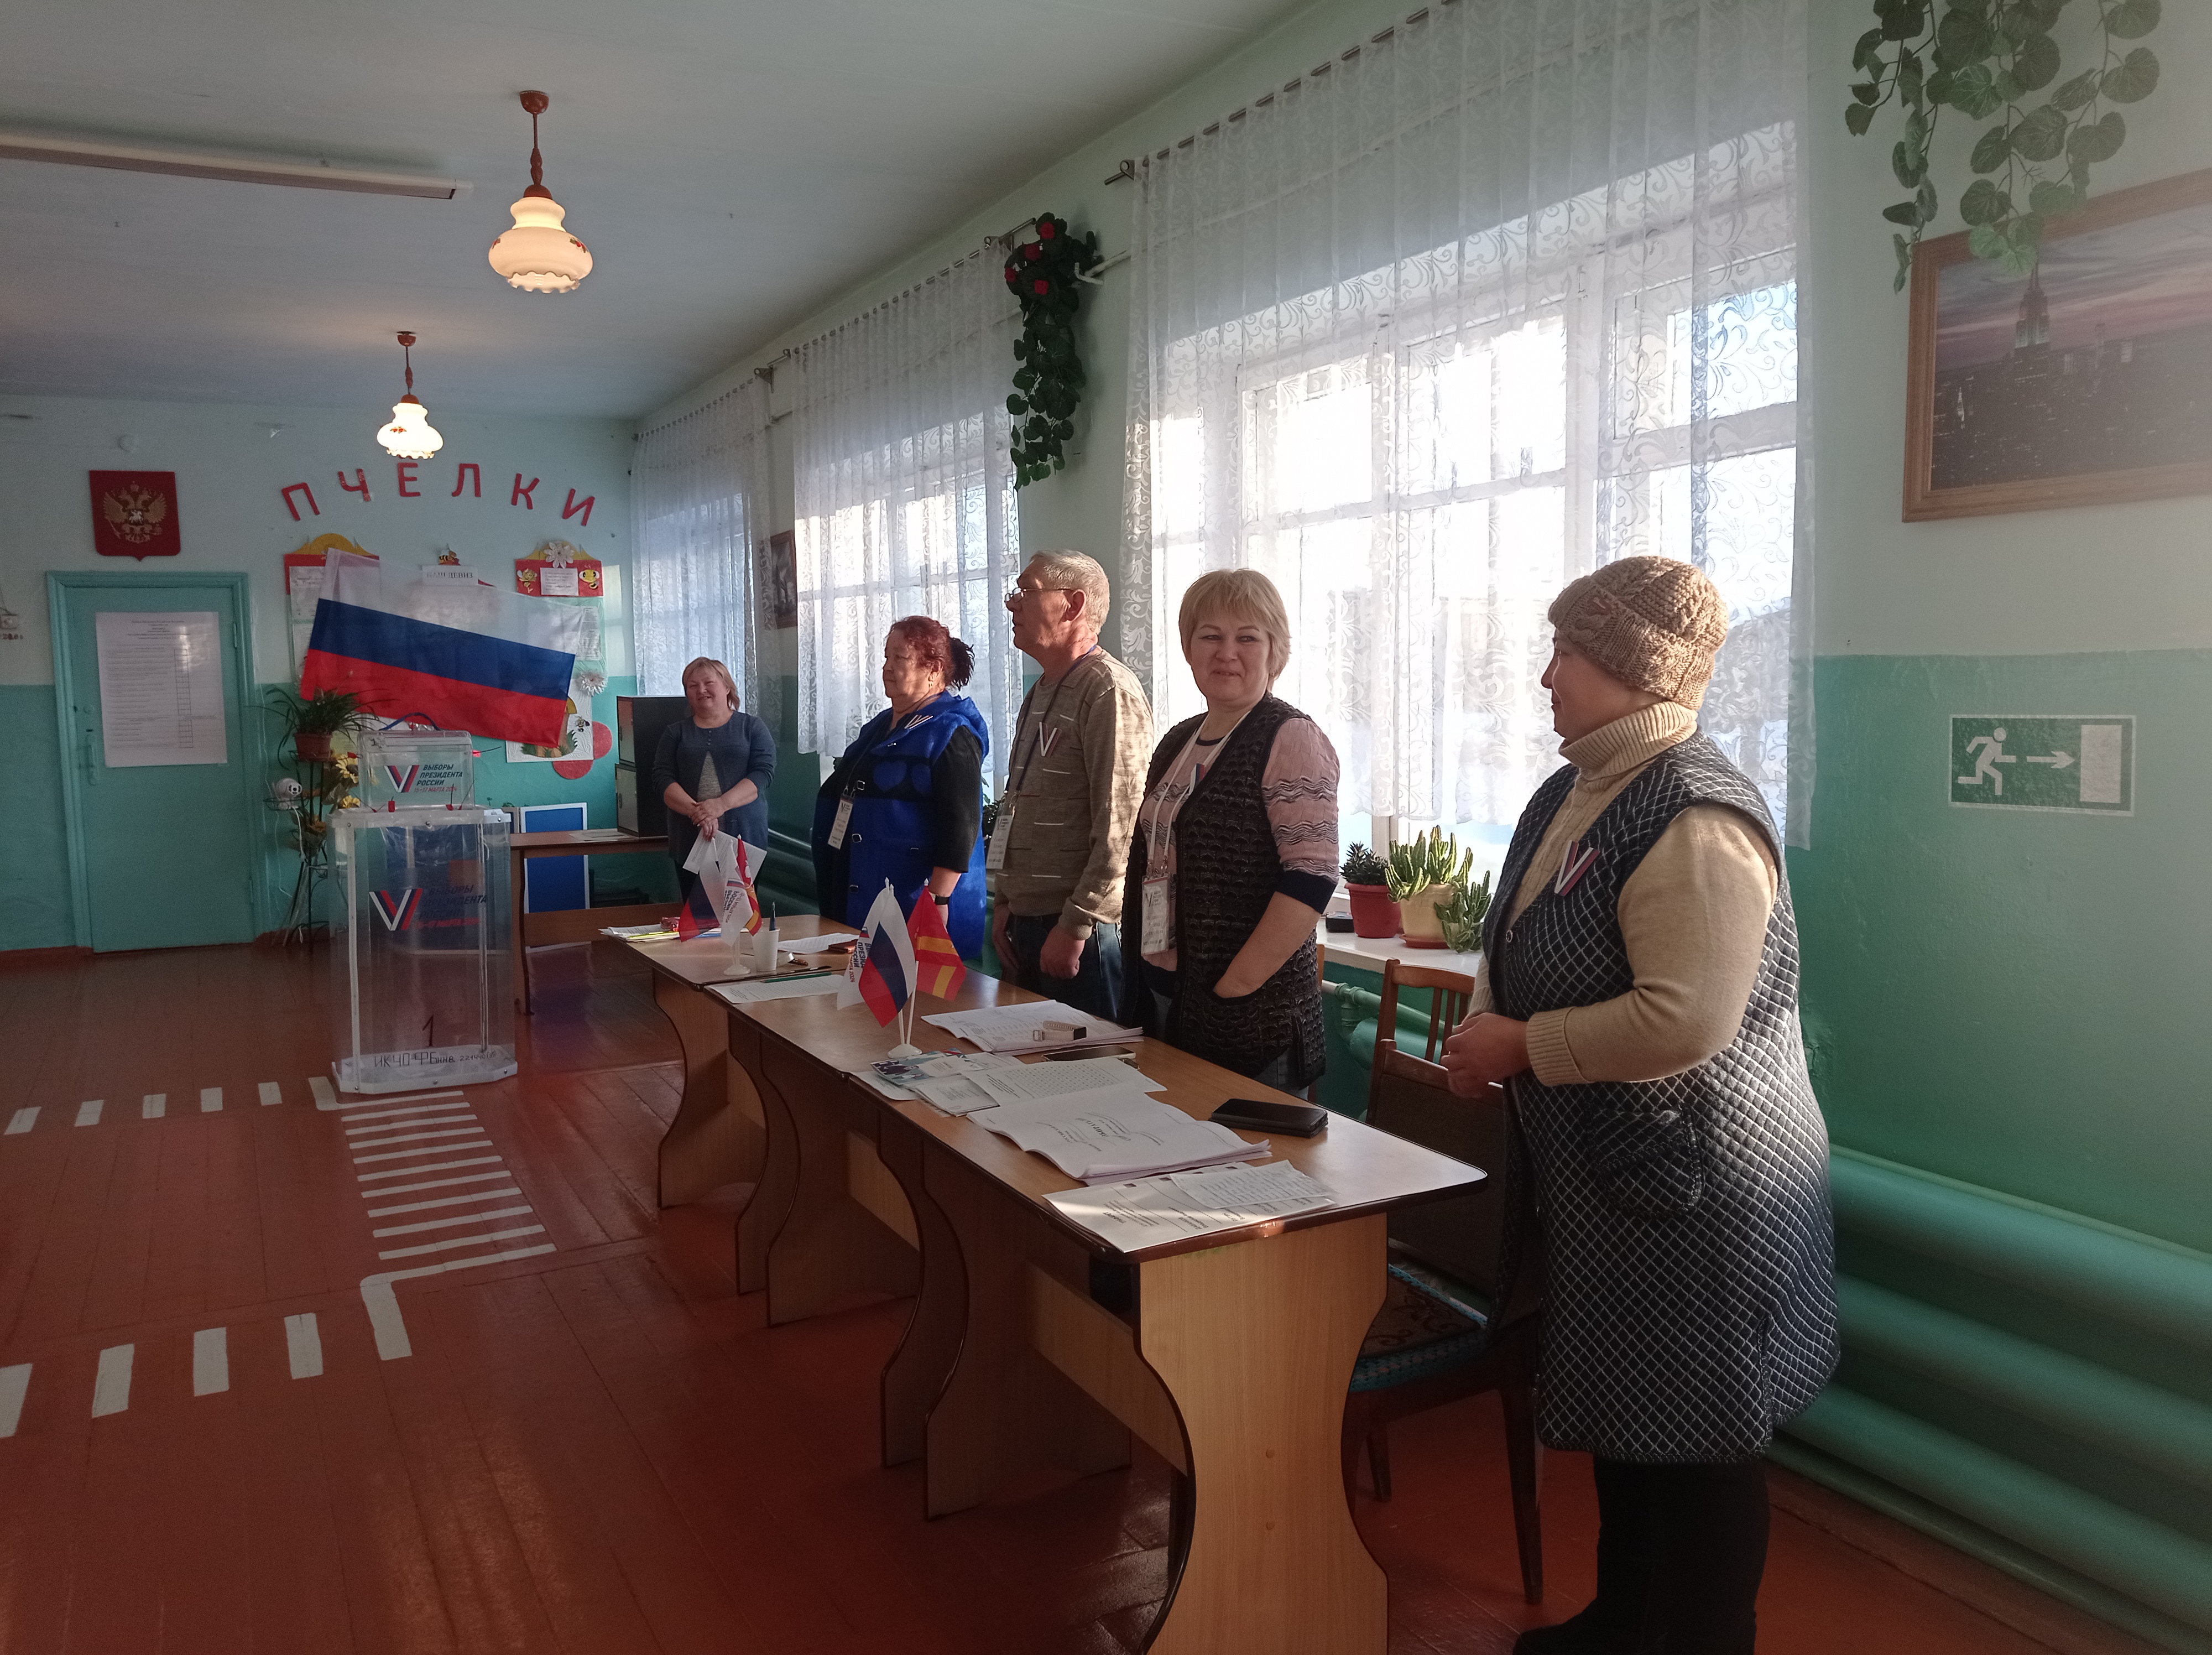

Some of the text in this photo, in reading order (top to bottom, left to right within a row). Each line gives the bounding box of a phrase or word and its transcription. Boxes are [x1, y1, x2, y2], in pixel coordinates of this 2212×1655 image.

[281, 462, 596, 527] ПЧЕЛКИ
[858, 942, 866, 968] ПРЕЗИД
[422, 1014, 435, 1048] 1
[1222, 1212, 1237, 1221] ПУТИН
